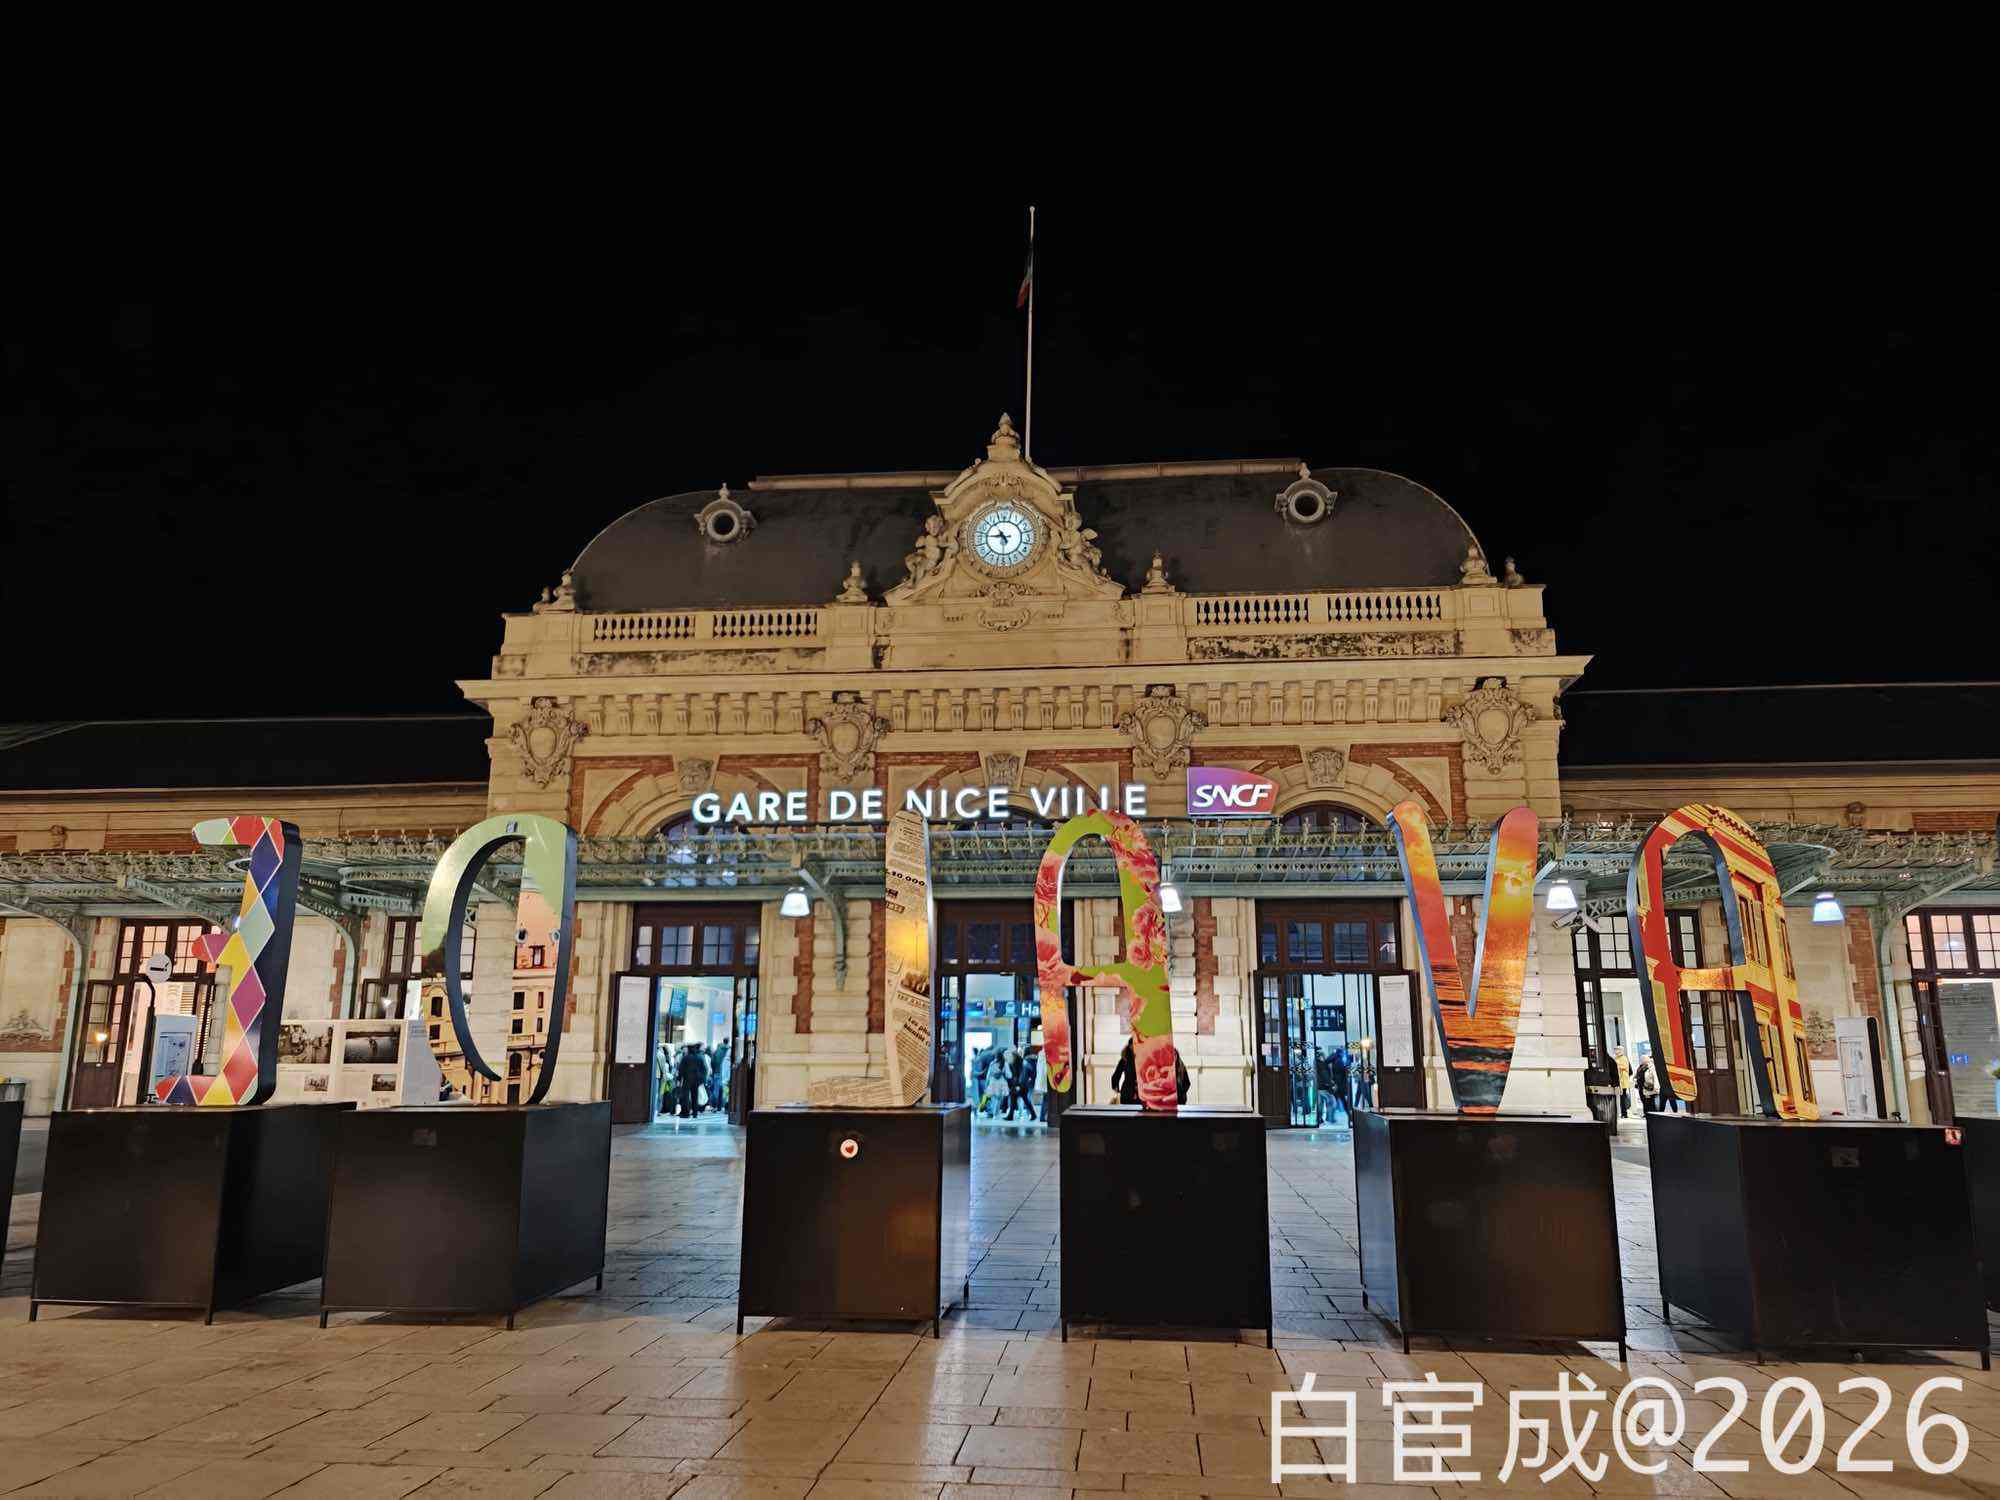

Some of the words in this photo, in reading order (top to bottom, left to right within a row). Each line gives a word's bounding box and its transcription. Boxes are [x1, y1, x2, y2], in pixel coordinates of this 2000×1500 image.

[691, 790, 809, 823] GARE
[829, 789, 884, 821] DE
[904, 786, 1010, 818] NICE
[1191, 784, 1273, 807] SNCF
